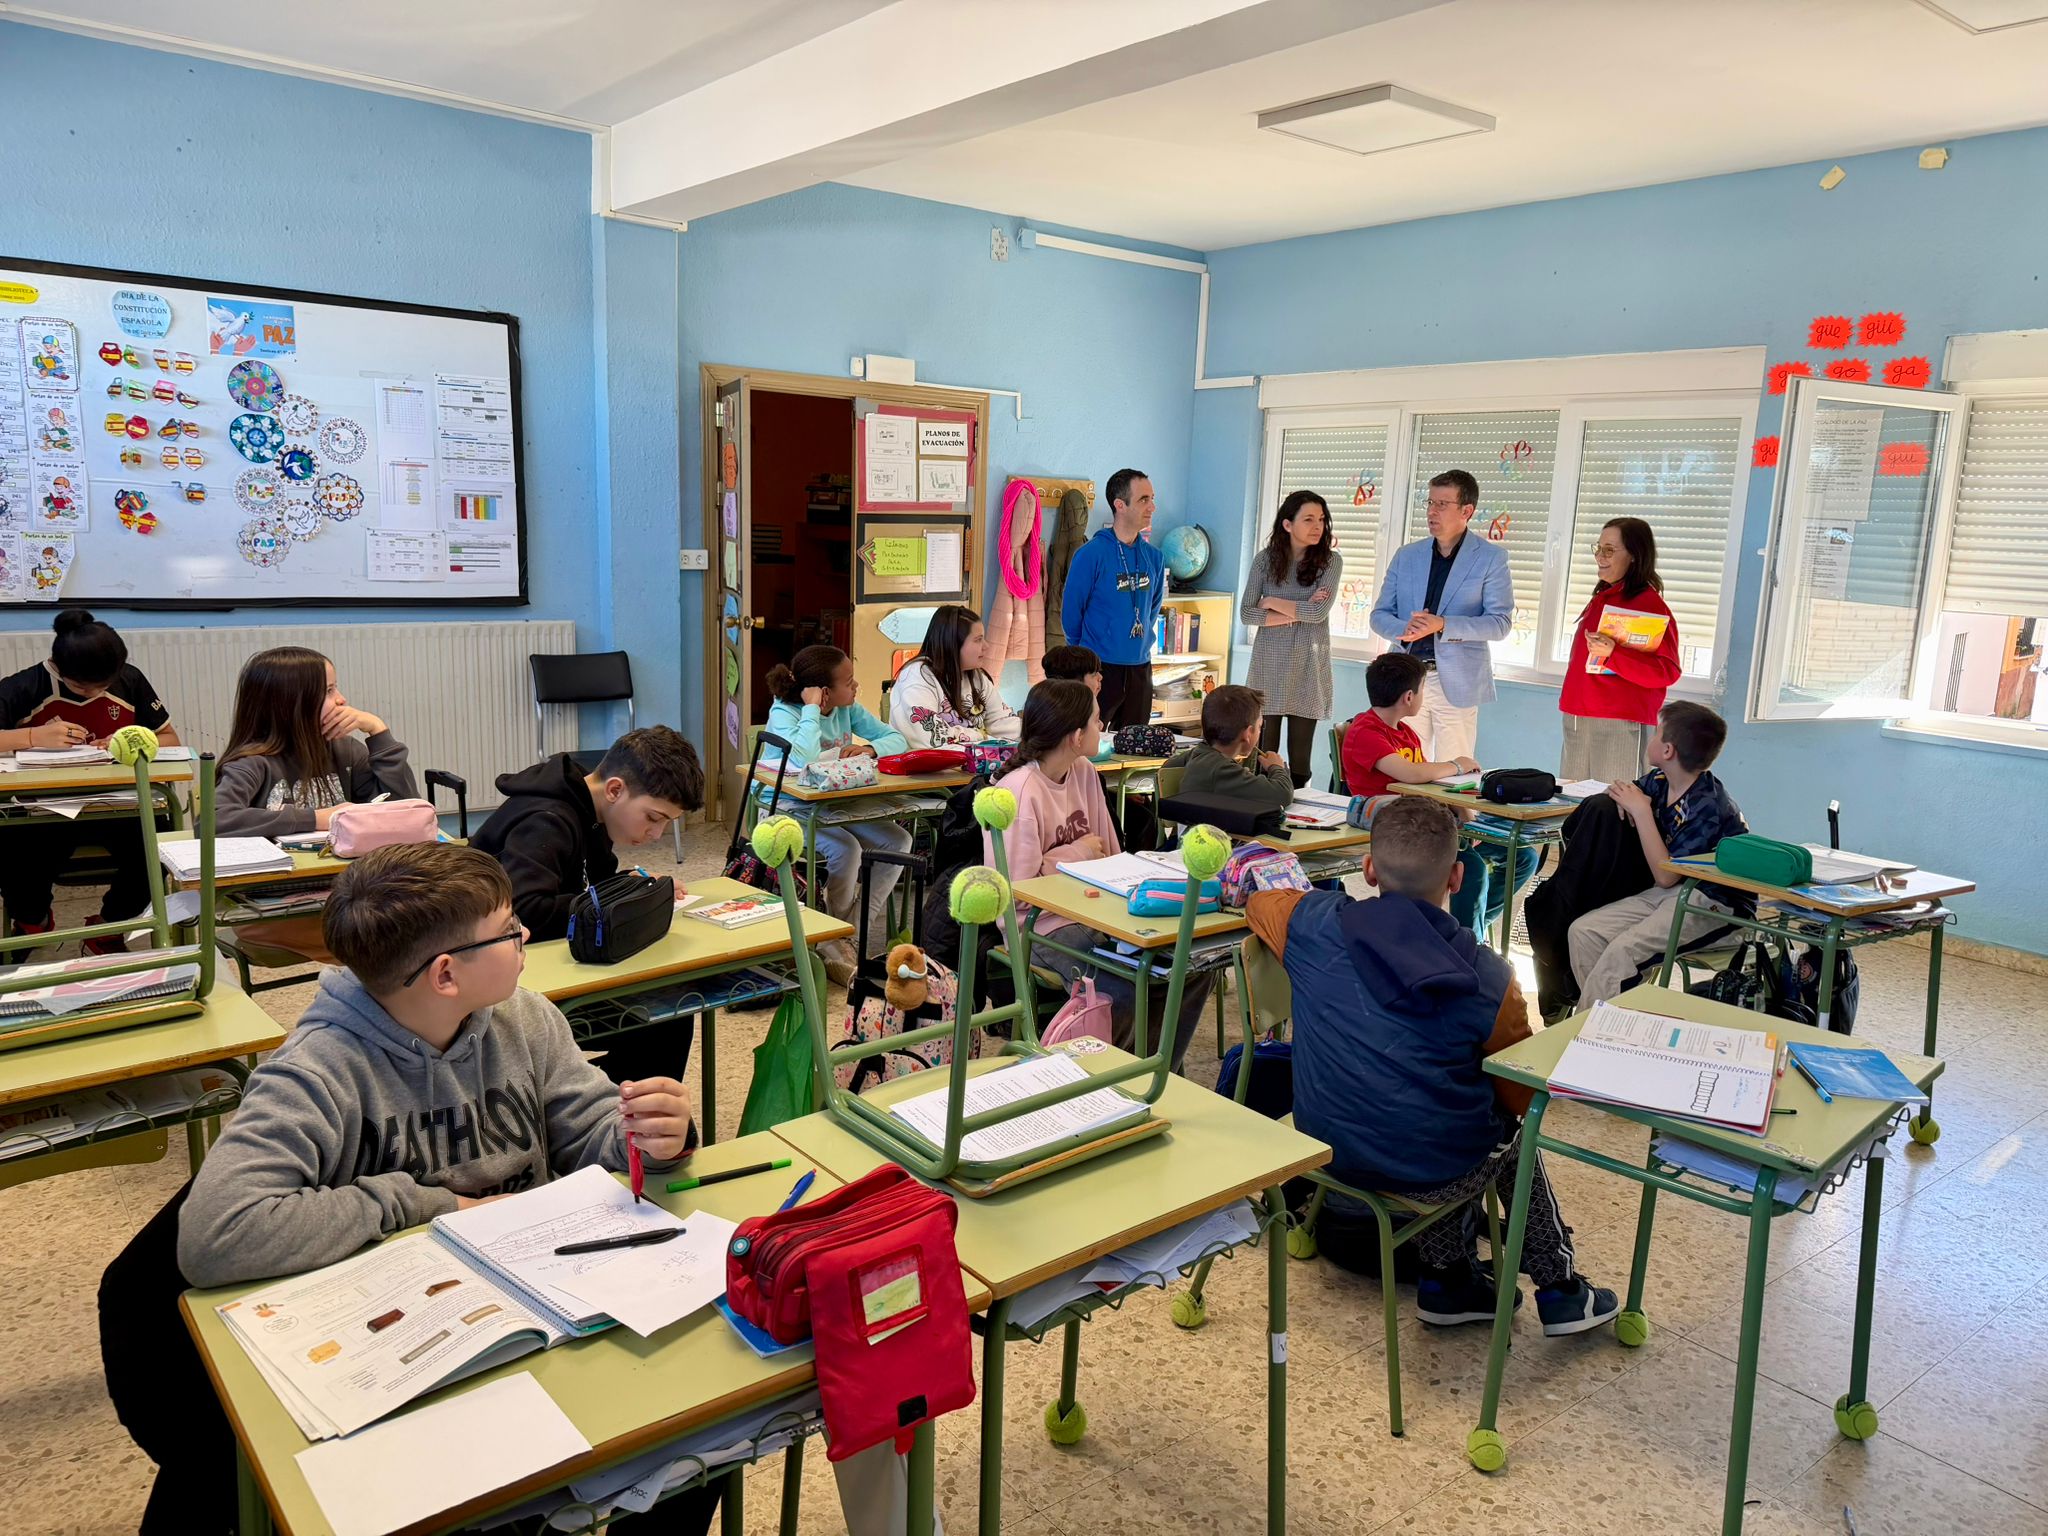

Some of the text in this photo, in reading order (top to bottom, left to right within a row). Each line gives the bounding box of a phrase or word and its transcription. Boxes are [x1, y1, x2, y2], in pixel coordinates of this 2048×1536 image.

[136, 293, 147, 301] DE
[113, 303, 167, 314] CONSTITUCIÓN
[121, 316, 162, 326] ESPAÑOLA
[263, 324, 296, 346] PAZ
[1832, 366, 1861, 378] go
[1893, 365, 1920, 384] ga
